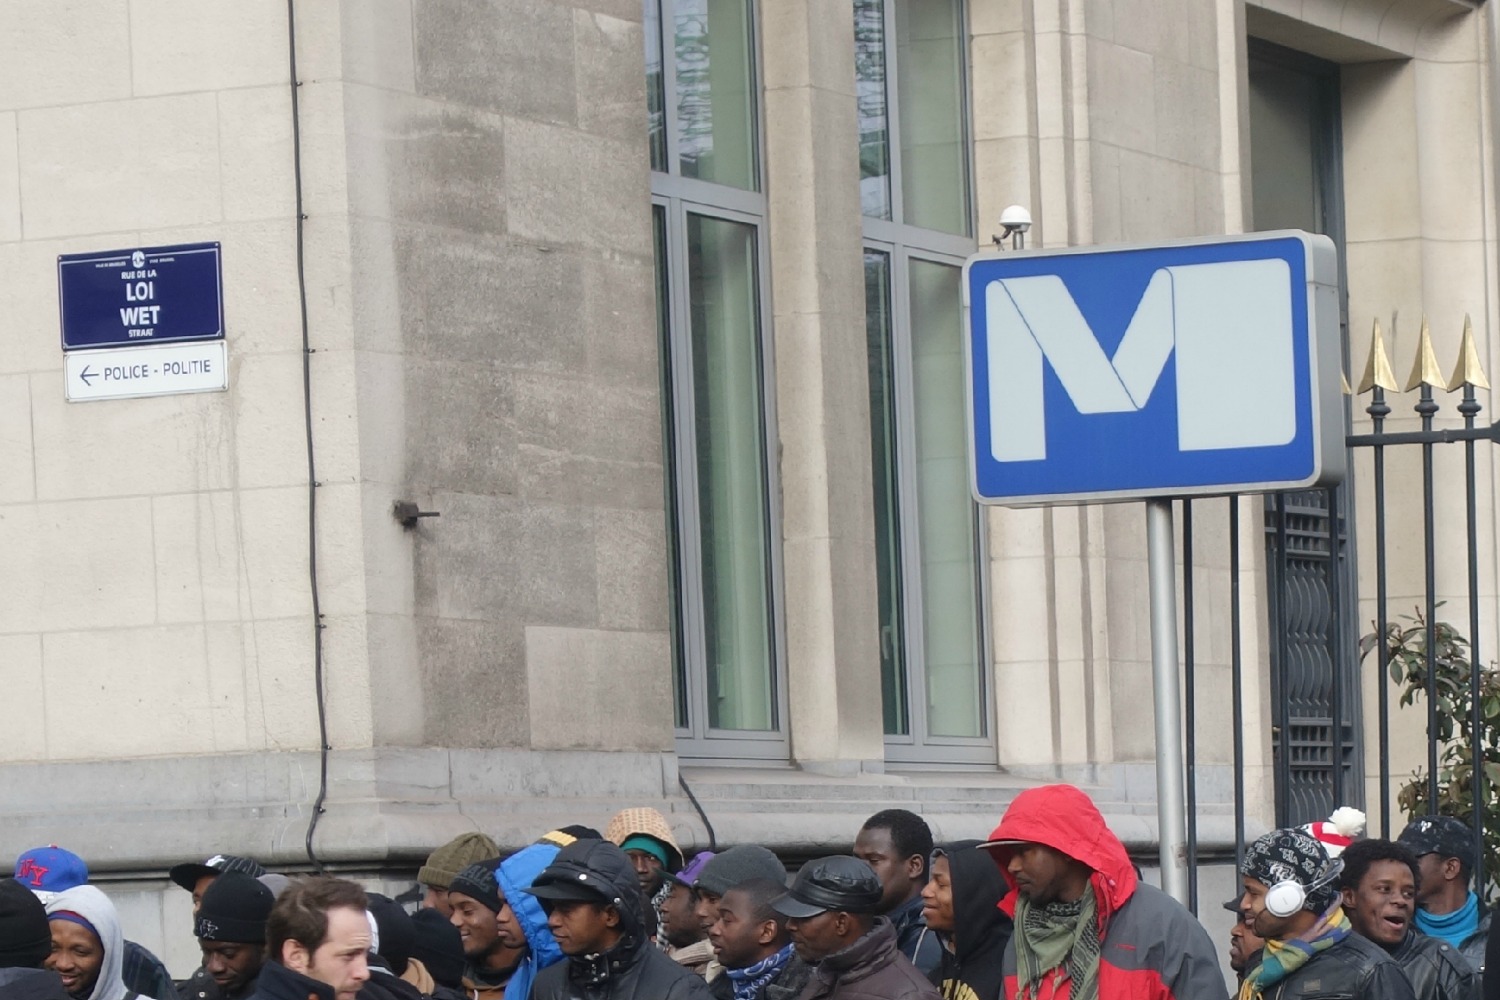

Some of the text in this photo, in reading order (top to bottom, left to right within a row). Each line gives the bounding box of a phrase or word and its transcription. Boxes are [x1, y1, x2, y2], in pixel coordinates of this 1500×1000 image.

[121, 269, 157, 280] RUE DE LA
[126, 281, 153, 301] LOI
[120, 305, 160, 326] WET
[128, 328, 154, 338] STRAAT
[104, 364, 149, 381] POLICE
[163, 359, 211, 376] POLITIE
[985, 258, 1297, 462] M
